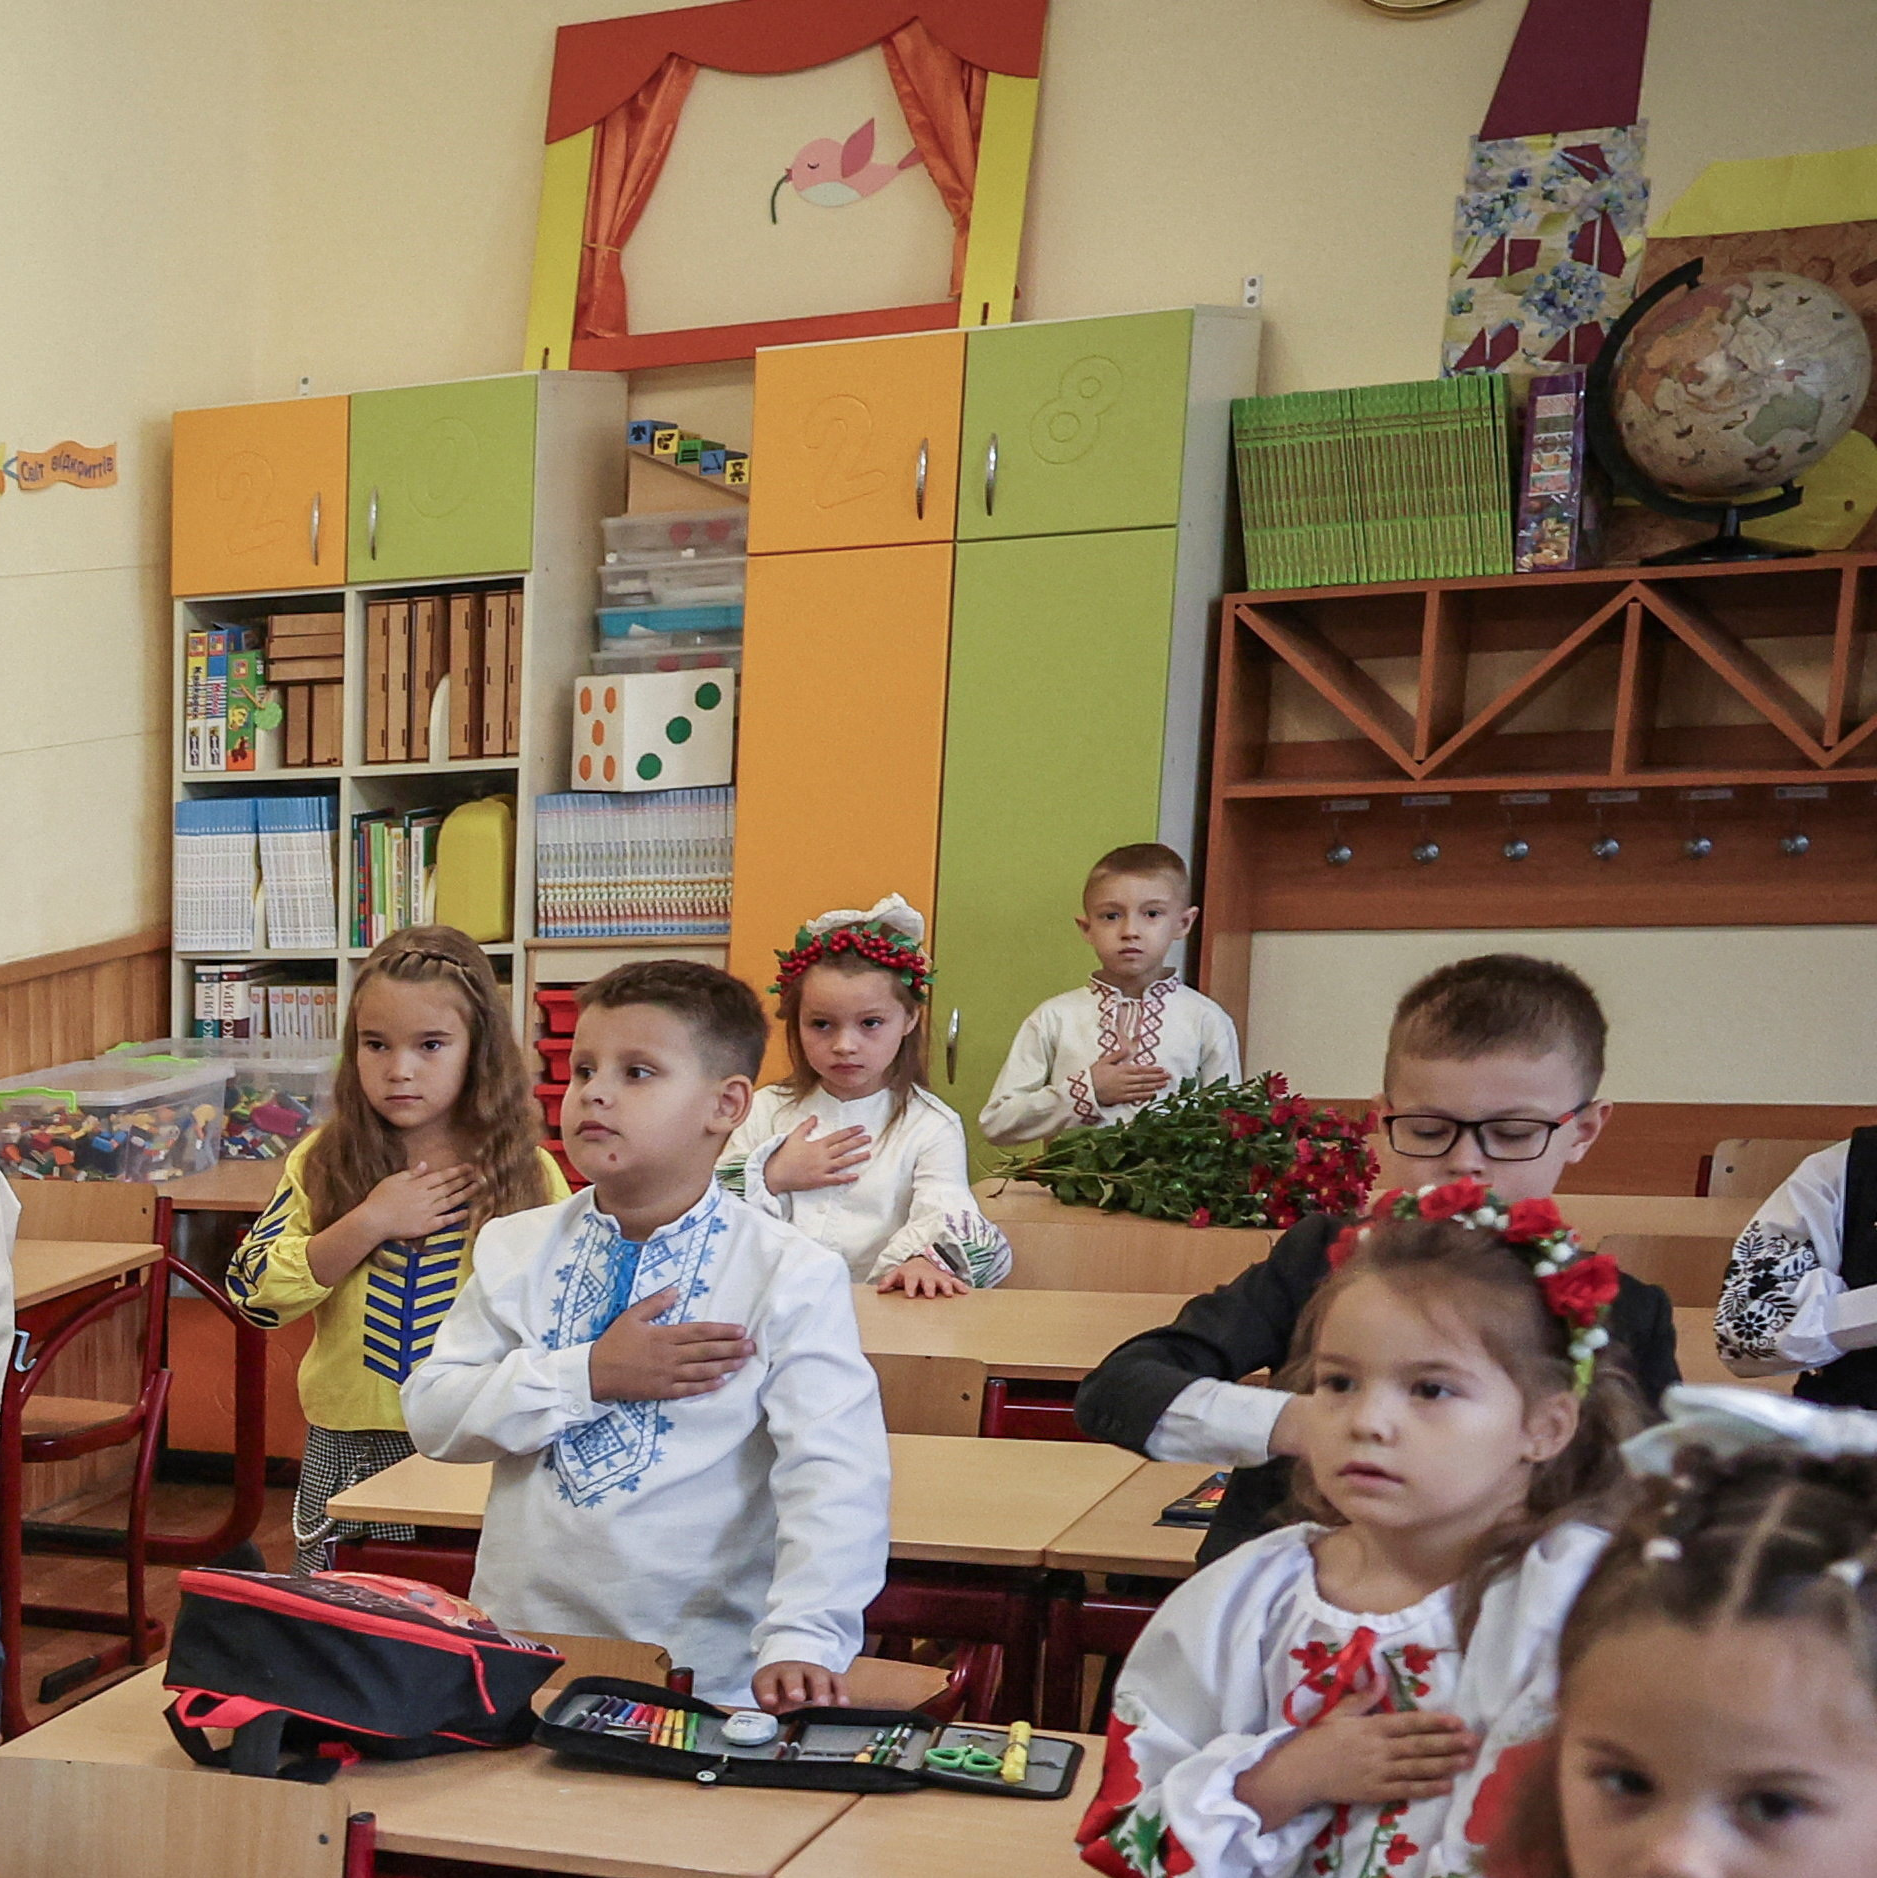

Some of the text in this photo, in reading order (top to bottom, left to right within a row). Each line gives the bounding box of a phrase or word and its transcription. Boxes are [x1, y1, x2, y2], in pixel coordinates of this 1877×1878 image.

[21, 451, 113, 482] Світ відкриттів
[203, 983, 214, 1038] КОЛЯРА
[222, 983, 235, 1038] КОЛЯРА
